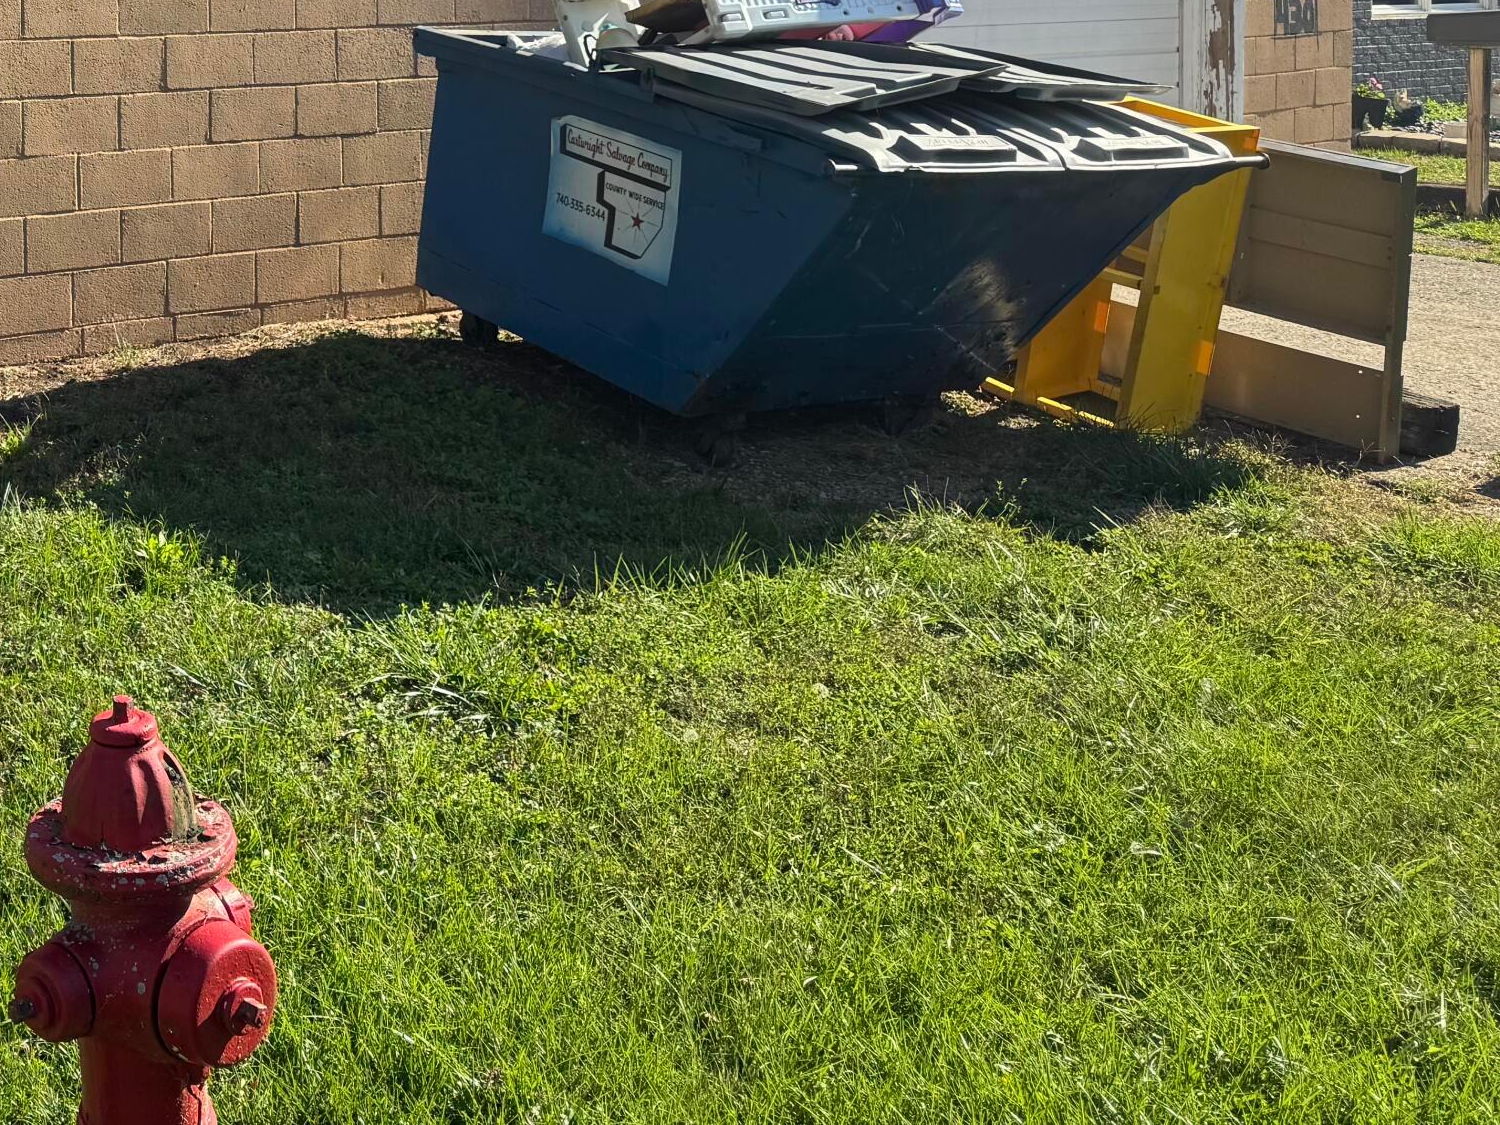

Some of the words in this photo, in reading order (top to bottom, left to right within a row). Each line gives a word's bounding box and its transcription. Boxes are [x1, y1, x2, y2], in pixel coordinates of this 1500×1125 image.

[567, 127, 605, 159] Cartwright
[606, 141, 636, 171] Salvage
[637, 152, 668, 183] Company
[556, 192, 606, 221] 740-335-6344
[605, 182, 627, 196] COUNTY
[628, 190, 642, 202] WIDE
[643, 195, 665, 210] SERVICE
